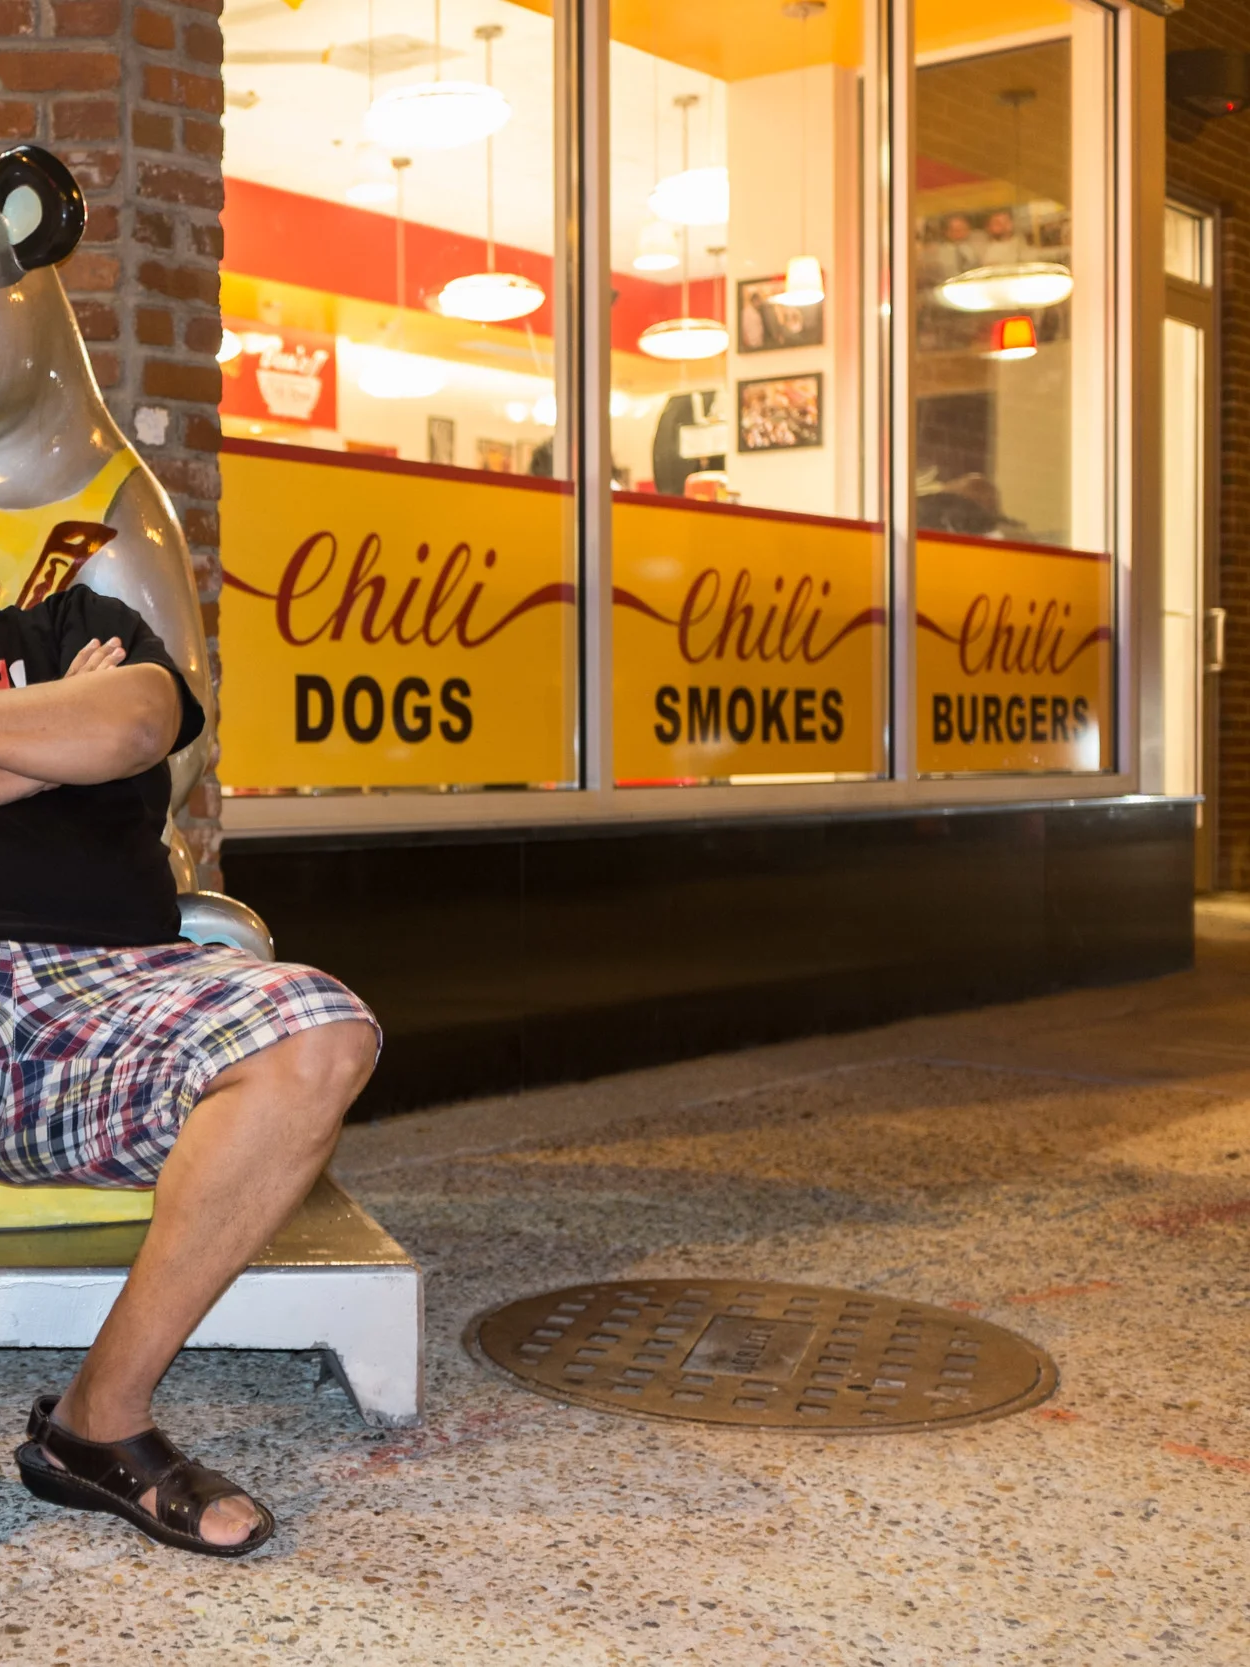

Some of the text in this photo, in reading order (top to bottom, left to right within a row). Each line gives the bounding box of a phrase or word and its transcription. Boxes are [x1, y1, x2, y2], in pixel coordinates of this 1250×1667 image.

[275, 530, 510, 649] Chili
[678, 567, 845, 665] Chili
[959, 592, 1082, 677] Chili
[294, 673, 474, 745] DOGS
[653, 684, 845, 746] SMOKES
[932, 692, 1090, 745] BURGERS
